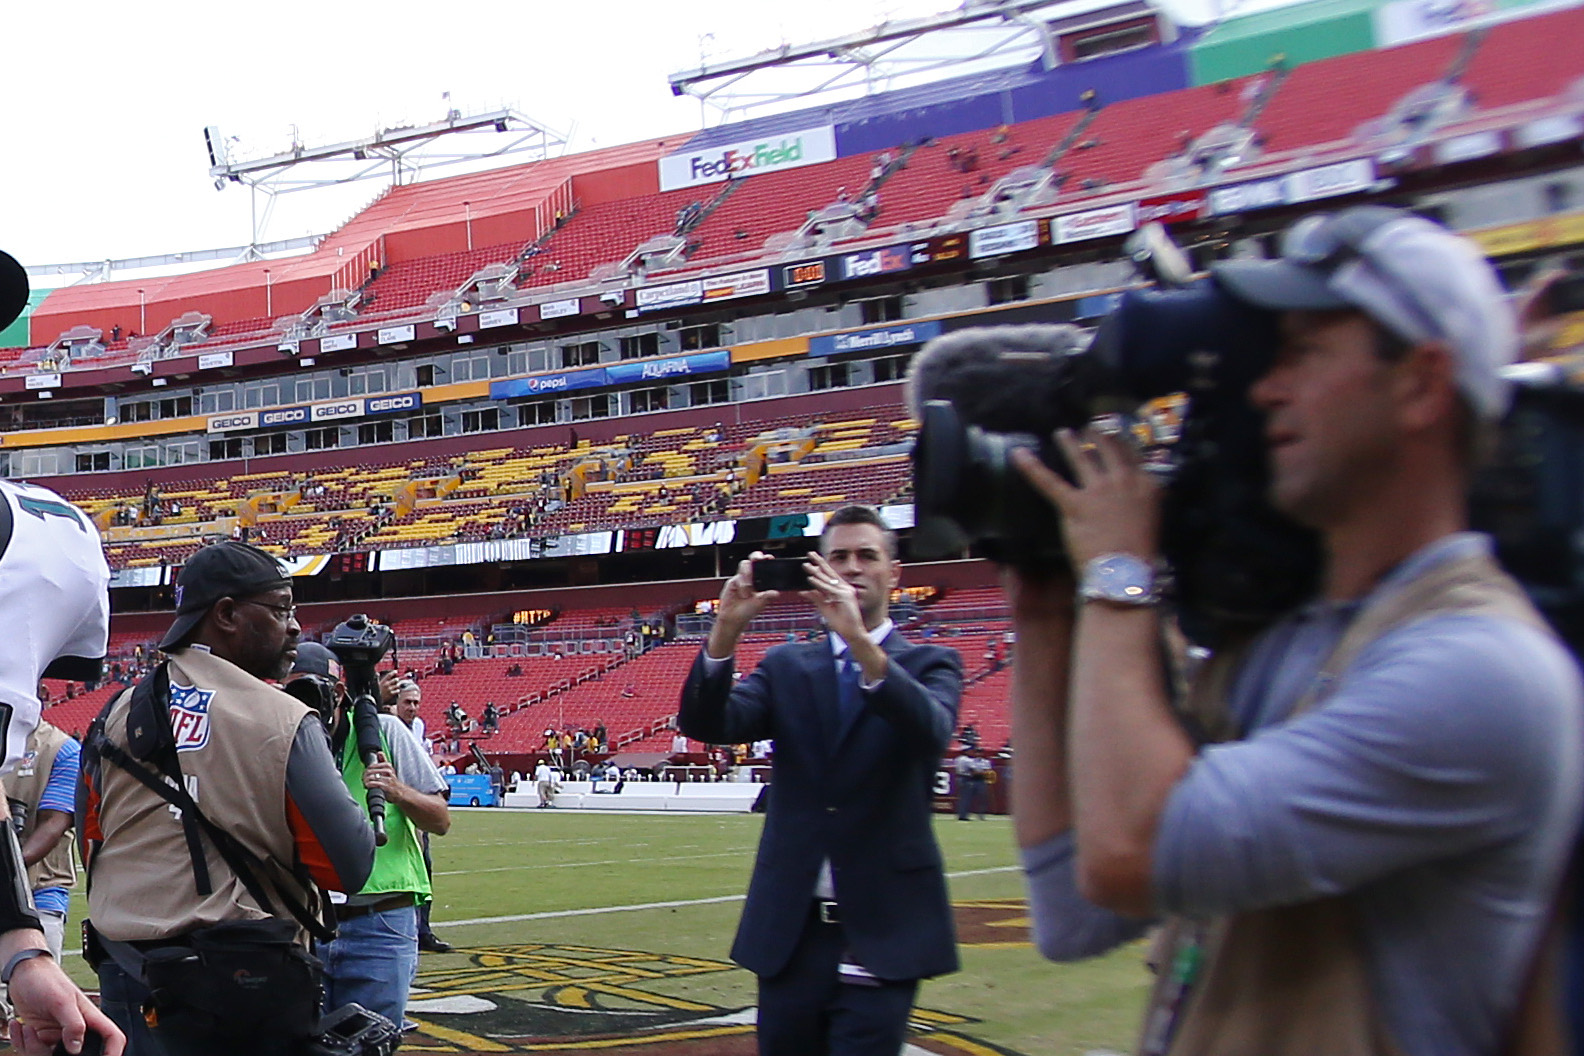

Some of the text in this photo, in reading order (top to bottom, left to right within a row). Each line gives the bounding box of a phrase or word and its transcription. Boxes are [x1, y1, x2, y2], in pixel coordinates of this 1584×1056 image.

[690, 138, 803, 179] FedExField
[845, 248, 905, 278] FedEx
[540, 377, 566, 390] pepsi
[316, 404, 357, 417] GEICO
[370, 397, 413, 411] GEICO
[212, 417, 251, 428] GEICO
[264, 409, 305, 424] GEICO
